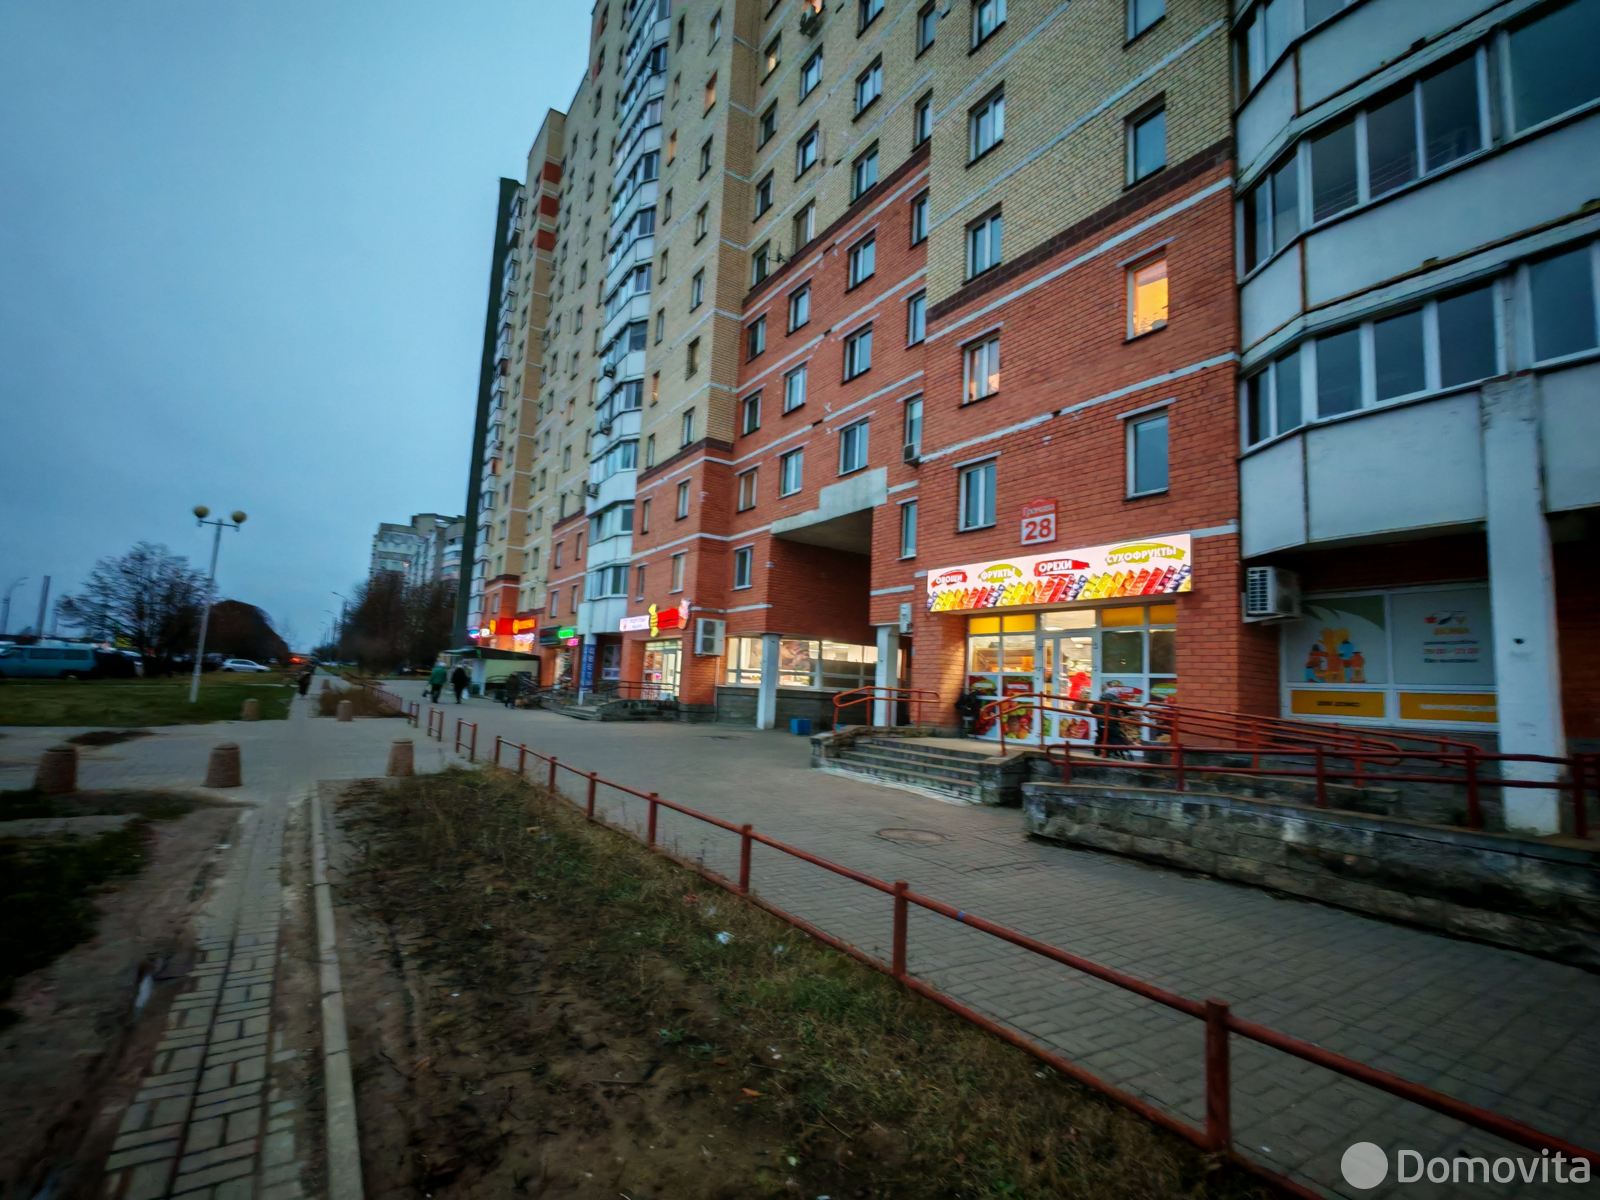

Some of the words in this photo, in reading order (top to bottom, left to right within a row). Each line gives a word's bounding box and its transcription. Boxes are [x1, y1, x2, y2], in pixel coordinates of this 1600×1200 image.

[1024, 518, 1052, 541] 28
[936, 574, 963, 584] ОВОЩИ
[981, 568, 1016, 580] ФРУКТЫ
[1038, 560, 1072, 572] ОРЕХИ
[1106, 547, 1177, 564] СУХОФРУКТЫ
